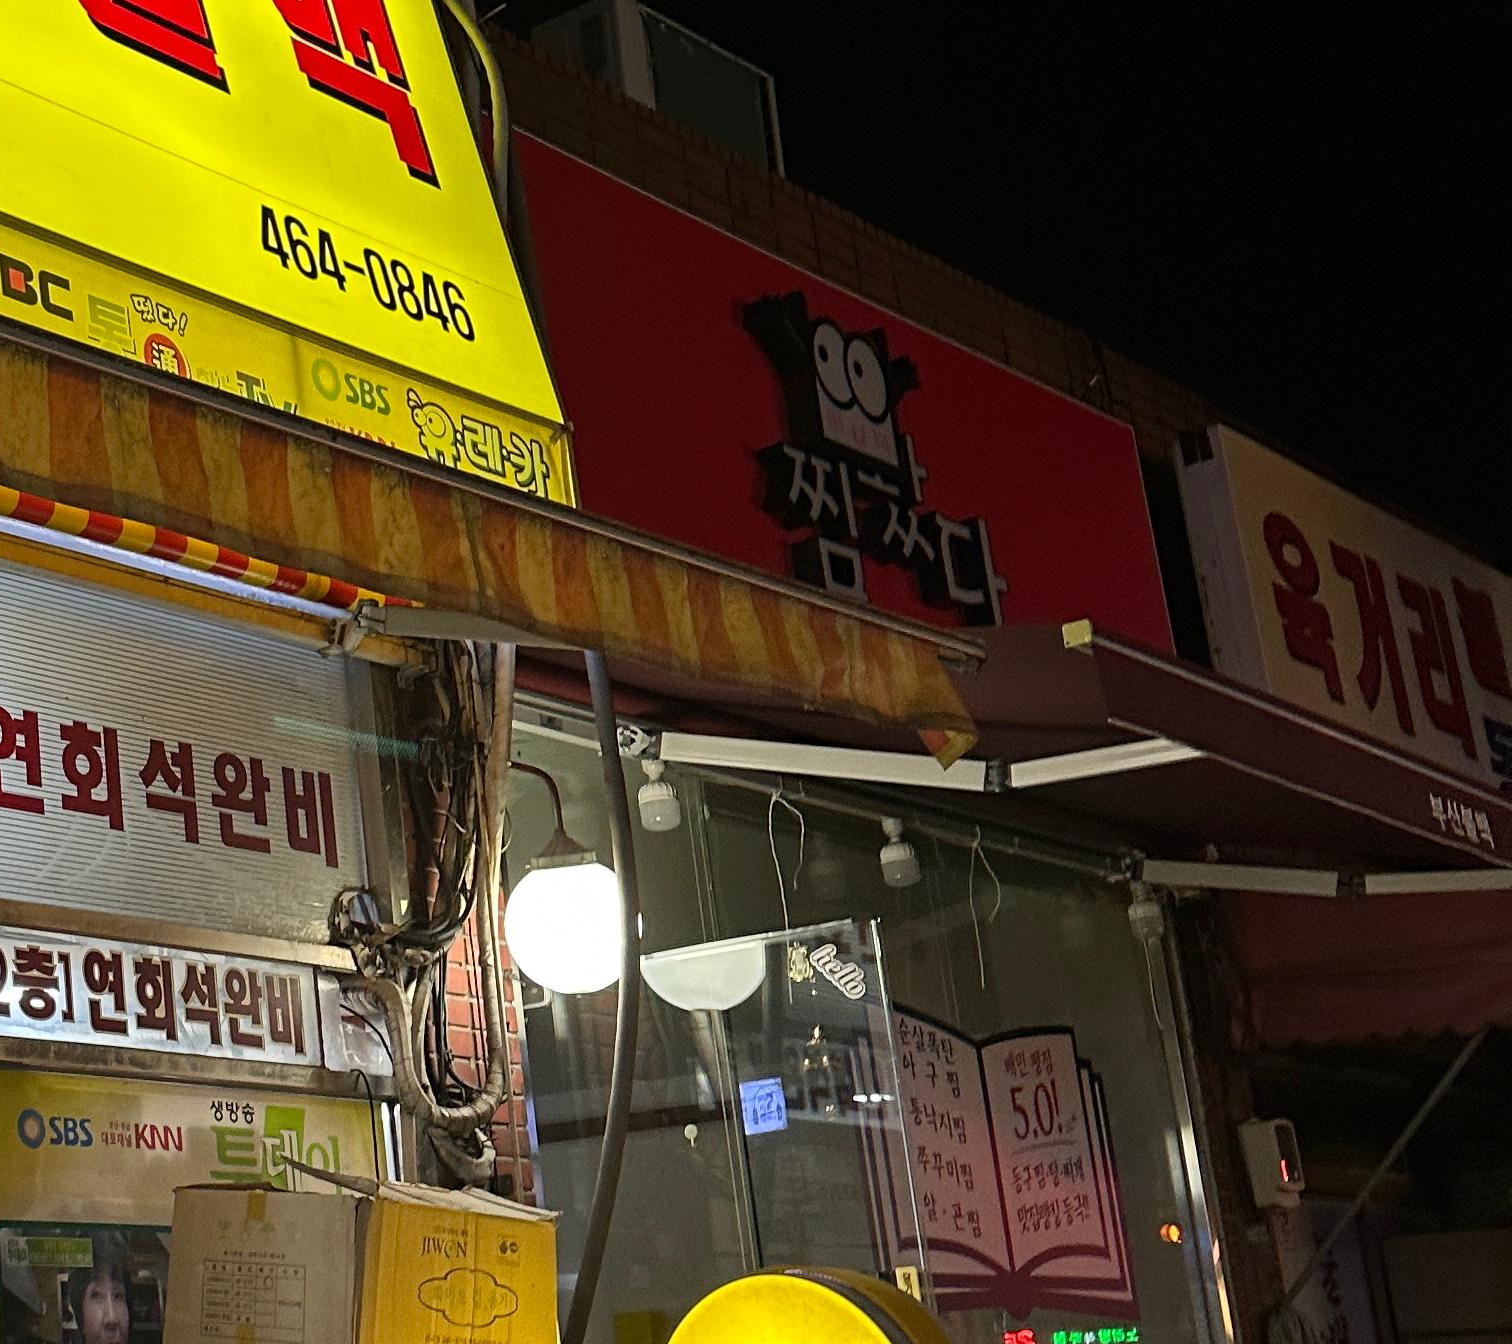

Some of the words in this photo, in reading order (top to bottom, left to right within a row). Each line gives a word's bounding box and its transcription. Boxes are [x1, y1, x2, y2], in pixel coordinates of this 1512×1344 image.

[261, 204, 476, 343] 464-0846
[344, 374, 392, 416] SBS
[810, 943, 866, 1001] hello
[83, 947, 307, 1055] 연회석완비
[48, 1116, 94, 1148] SBS
[210, 1099, 256, 1125] 생방송
[135, 1122, 184, 1152] KNN
